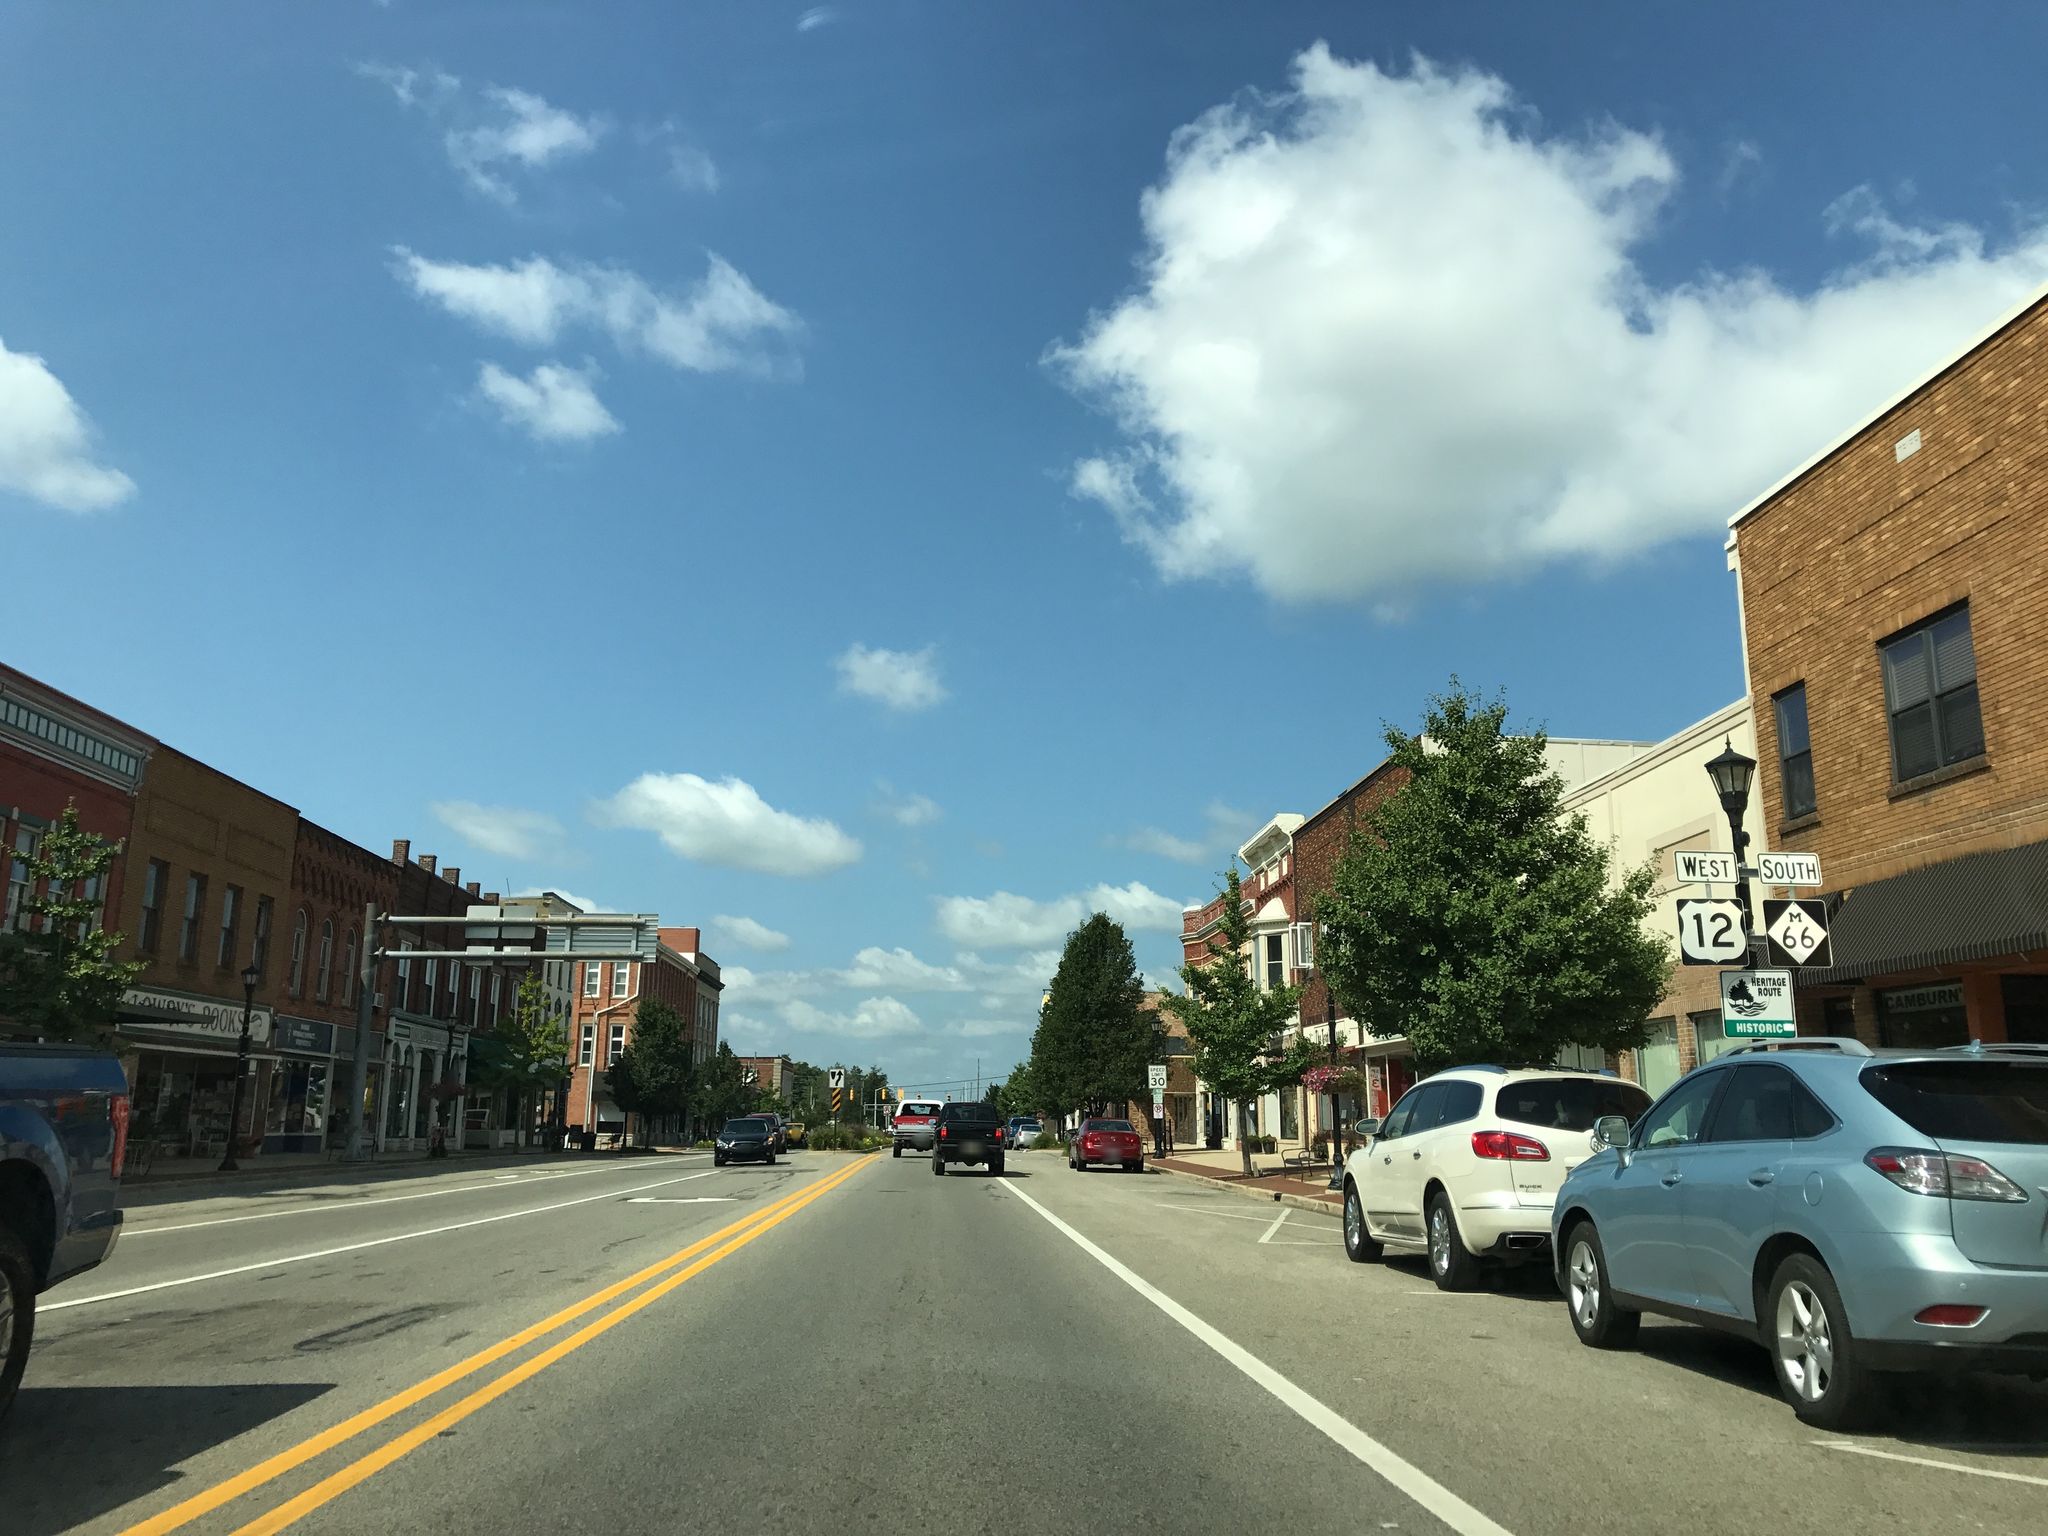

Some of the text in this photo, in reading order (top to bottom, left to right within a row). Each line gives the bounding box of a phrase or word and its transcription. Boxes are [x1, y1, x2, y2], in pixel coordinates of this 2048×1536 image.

[1682, 856, 1729, 878] WEST
[1762, 859, 1818, 881] SOUTH
[1789, 912, 1802, 923] M
[1692, 912, 1735, 948] 12
[1782, 926, 1815, 950] 66
[1751, 977, 1787, 987] HERITAGE
[1757, 987, 1782, 997] ROUTE
[201, 1005, 245, 1033] BOOKS
[1736, 1022, 1783, 1034] HISTORIC
[1150, 1077, 1165, 1086] 30
